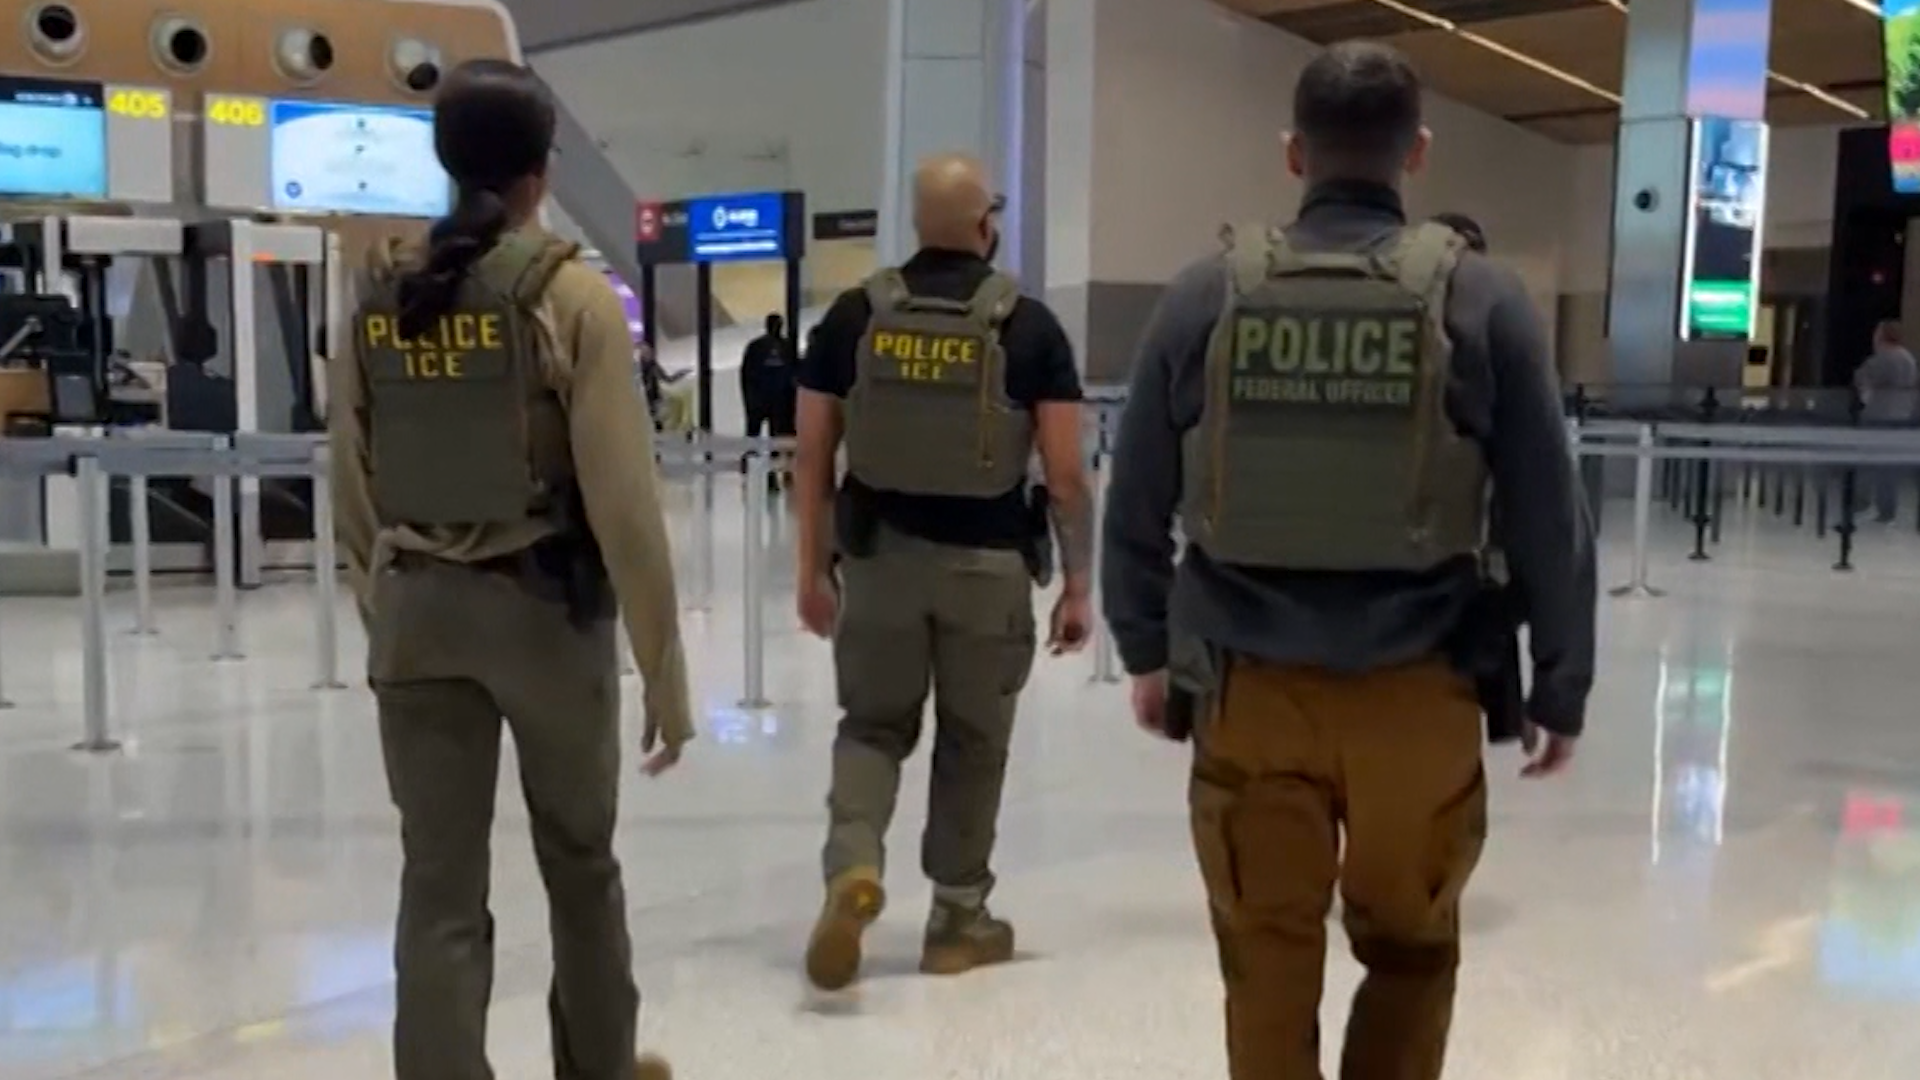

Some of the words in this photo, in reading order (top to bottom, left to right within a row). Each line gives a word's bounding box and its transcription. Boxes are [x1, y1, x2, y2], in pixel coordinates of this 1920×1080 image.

[109, 89, 166, 119] 405
[209, 99, 266, 127] 406
[874, 332, 977, 363] POLICE
[1235, 316, 1417, 375] POLICE
[404, 350, 465, 378] ICE
[900, 360, 943, 381] ICE
[1232, 376, 1321, 402] FEDERAL
[1325, 377, 1412, 405] OFFICER
